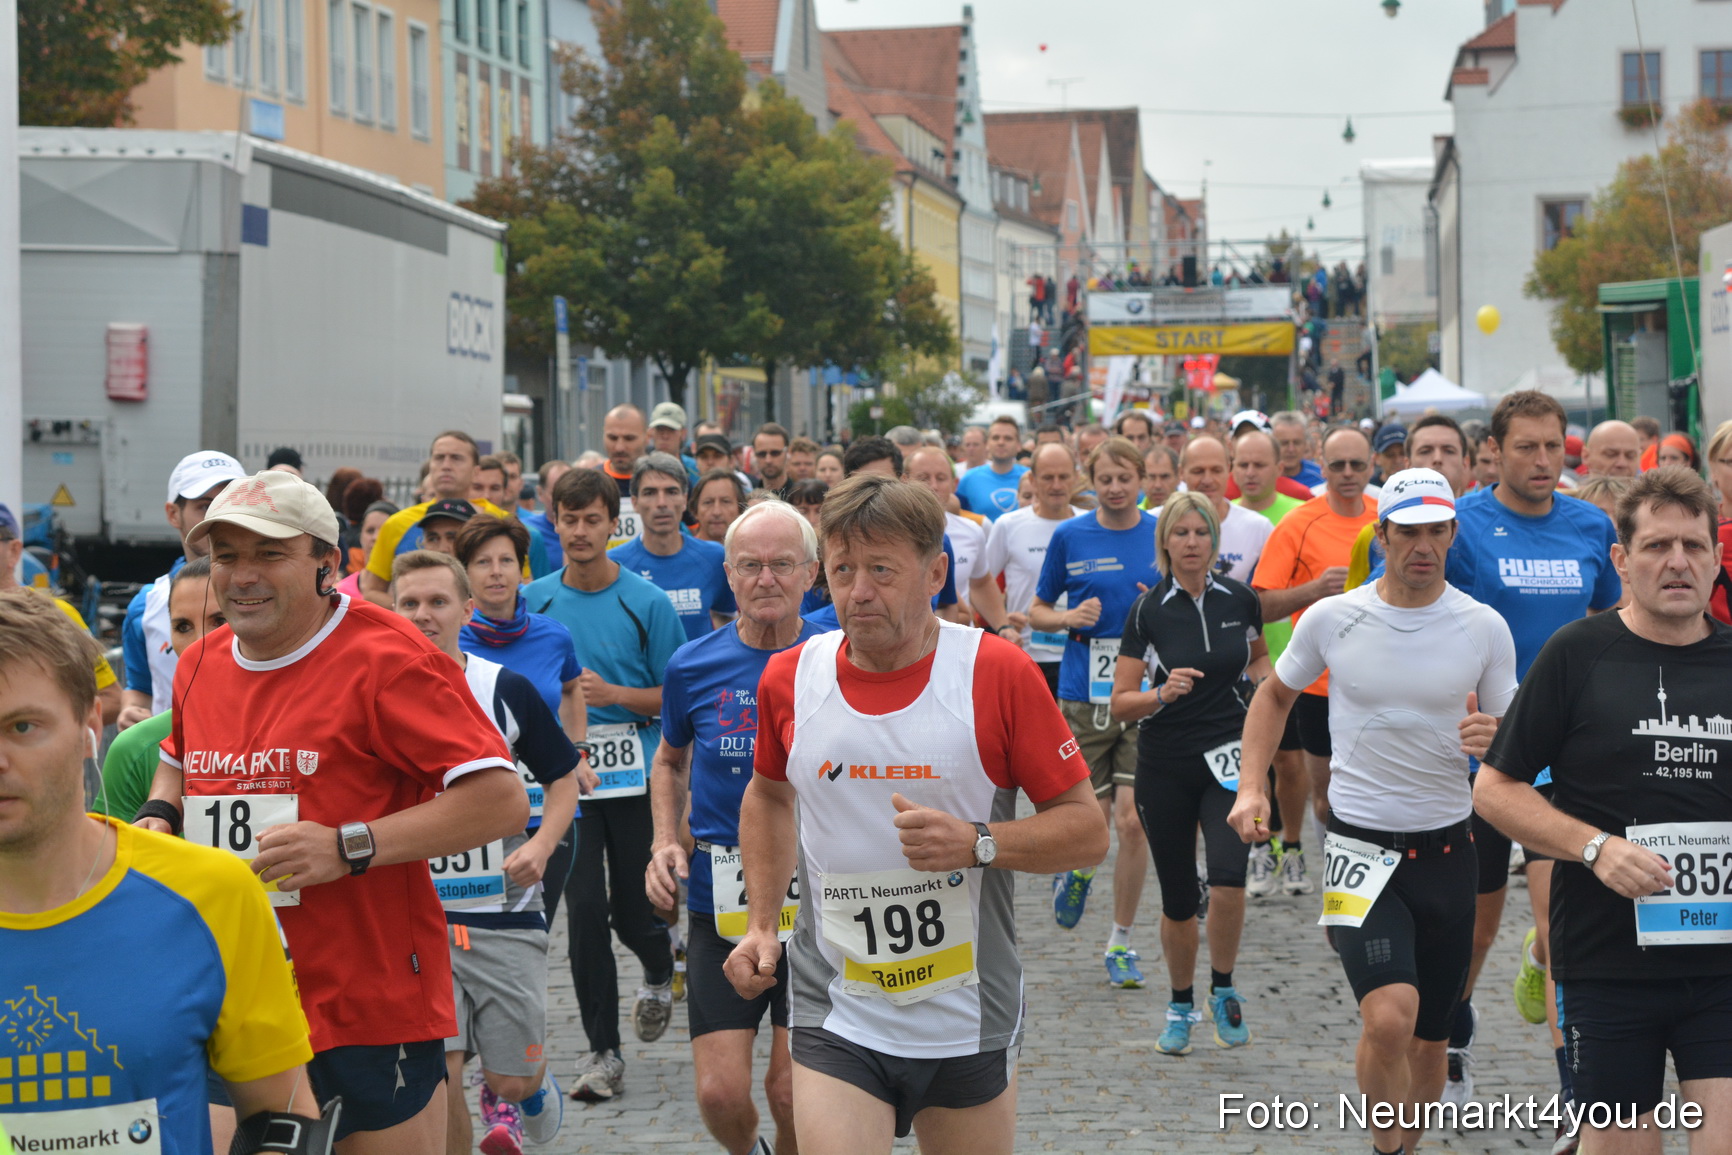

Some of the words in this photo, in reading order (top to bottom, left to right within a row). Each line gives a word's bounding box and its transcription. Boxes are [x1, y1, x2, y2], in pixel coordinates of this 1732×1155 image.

[1155, 330, 1227, 348] START
[1498, 558, 1582, 577] HUBER
[1519, 578, 1579, 586] TECHNOLOGY
[739, 697, 758, 706] MA
[720, 737, 745, 750] DU
[1654, 740, 1718, 764] Berlin
[184, 748, 290, 775] NEUMARKT
[849, 765, 941, 779] KLEBL
[1656, 766, 1692, 779] 42,195
[1696, 768, 1712, 779] km
[236, 781, 266, 790] STARKE
[205, 799, 252, 851] 18
[1631, 836, 1676, 848] PARTL
[1678, 834, 1730, 846] Neumarkt
[824, 887, 868, 900] PARTL
[871, 879, 943, 899] Neumarkt
[1680, 909, 1718, 926] Peter
[853, 899, 945, 955] 198
[871, 963, 935, 988] Rainer
[10, 1128, 120, 1153] Neumarkt
